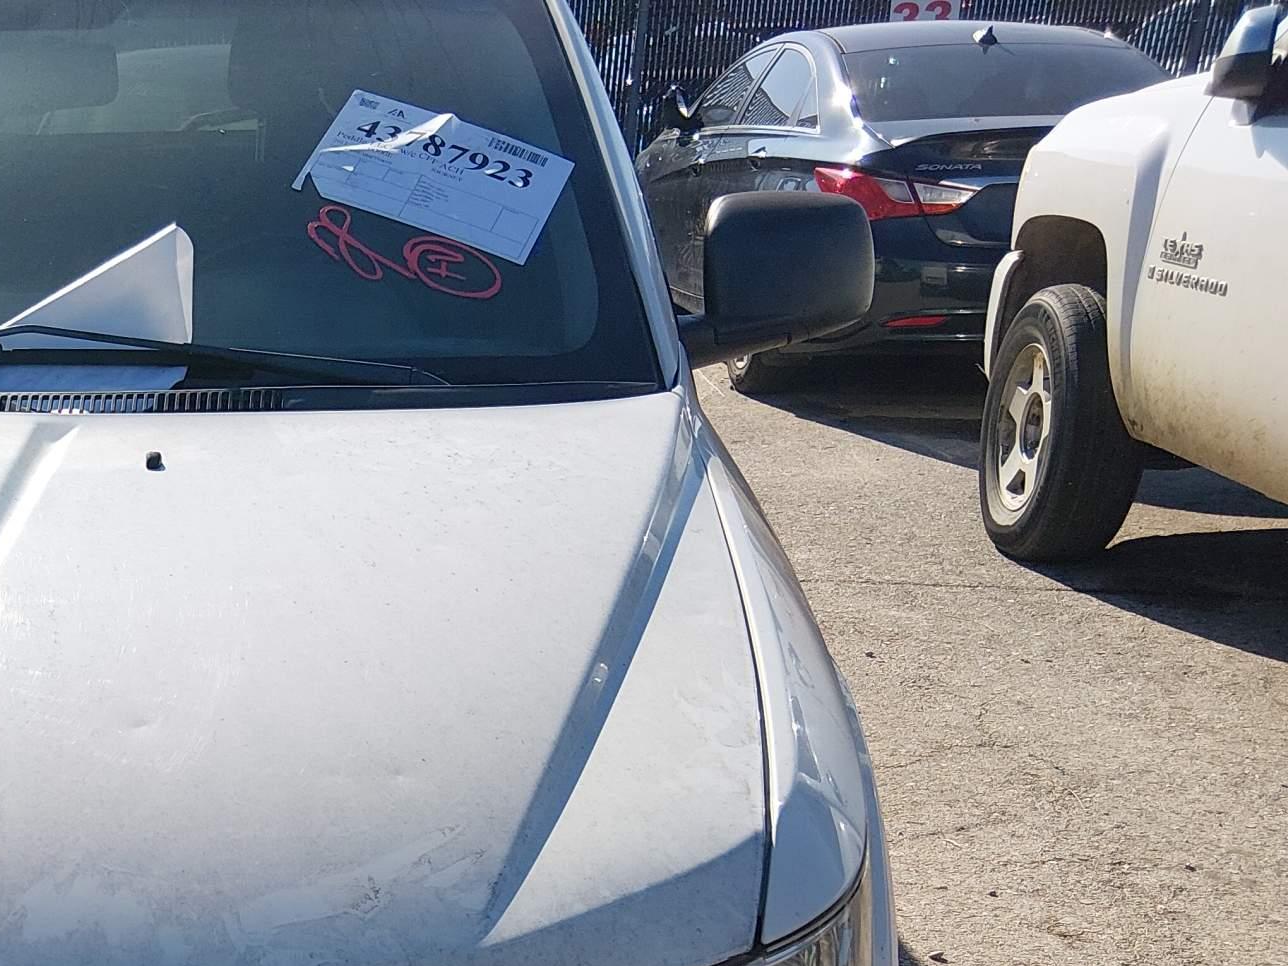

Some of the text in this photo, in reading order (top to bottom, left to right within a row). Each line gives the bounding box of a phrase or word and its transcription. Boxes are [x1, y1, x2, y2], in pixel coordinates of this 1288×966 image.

[356, 120, 534, 189] 43787923
[915, 163, 983, 171] SONATA
[1156, 268, 1228, 297] SILVERADO
